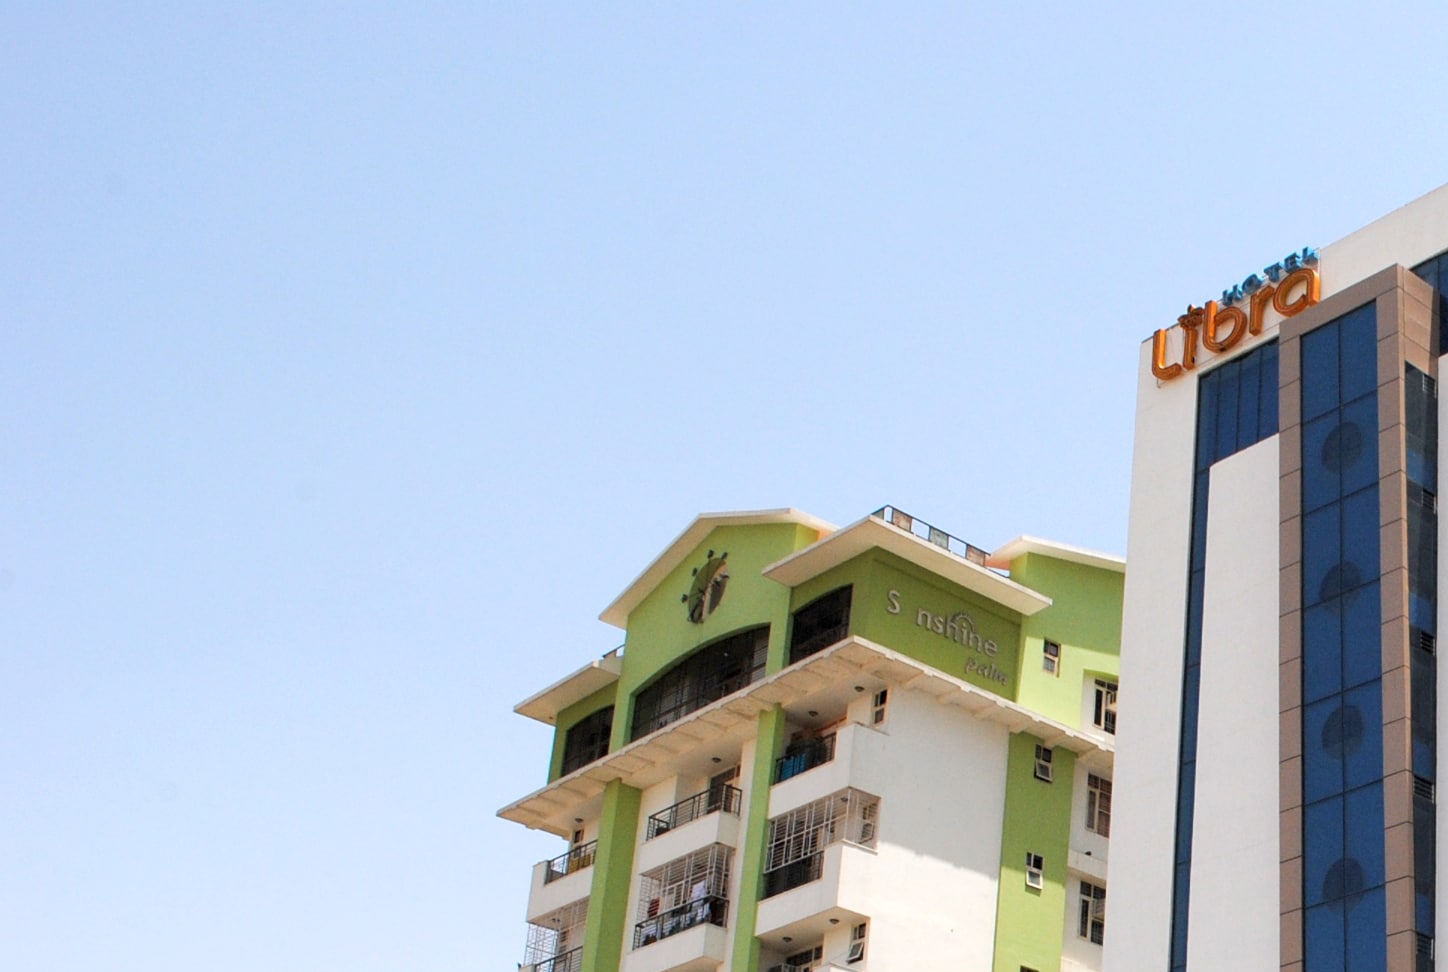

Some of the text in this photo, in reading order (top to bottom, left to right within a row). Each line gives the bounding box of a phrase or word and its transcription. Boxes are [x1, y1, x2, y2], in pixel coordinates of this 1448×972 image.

[1222, 246, 1319, 306] HOTEL
[1152, 267, 1321, 380] Libra
[887, 589, 998, 657] Snshine
